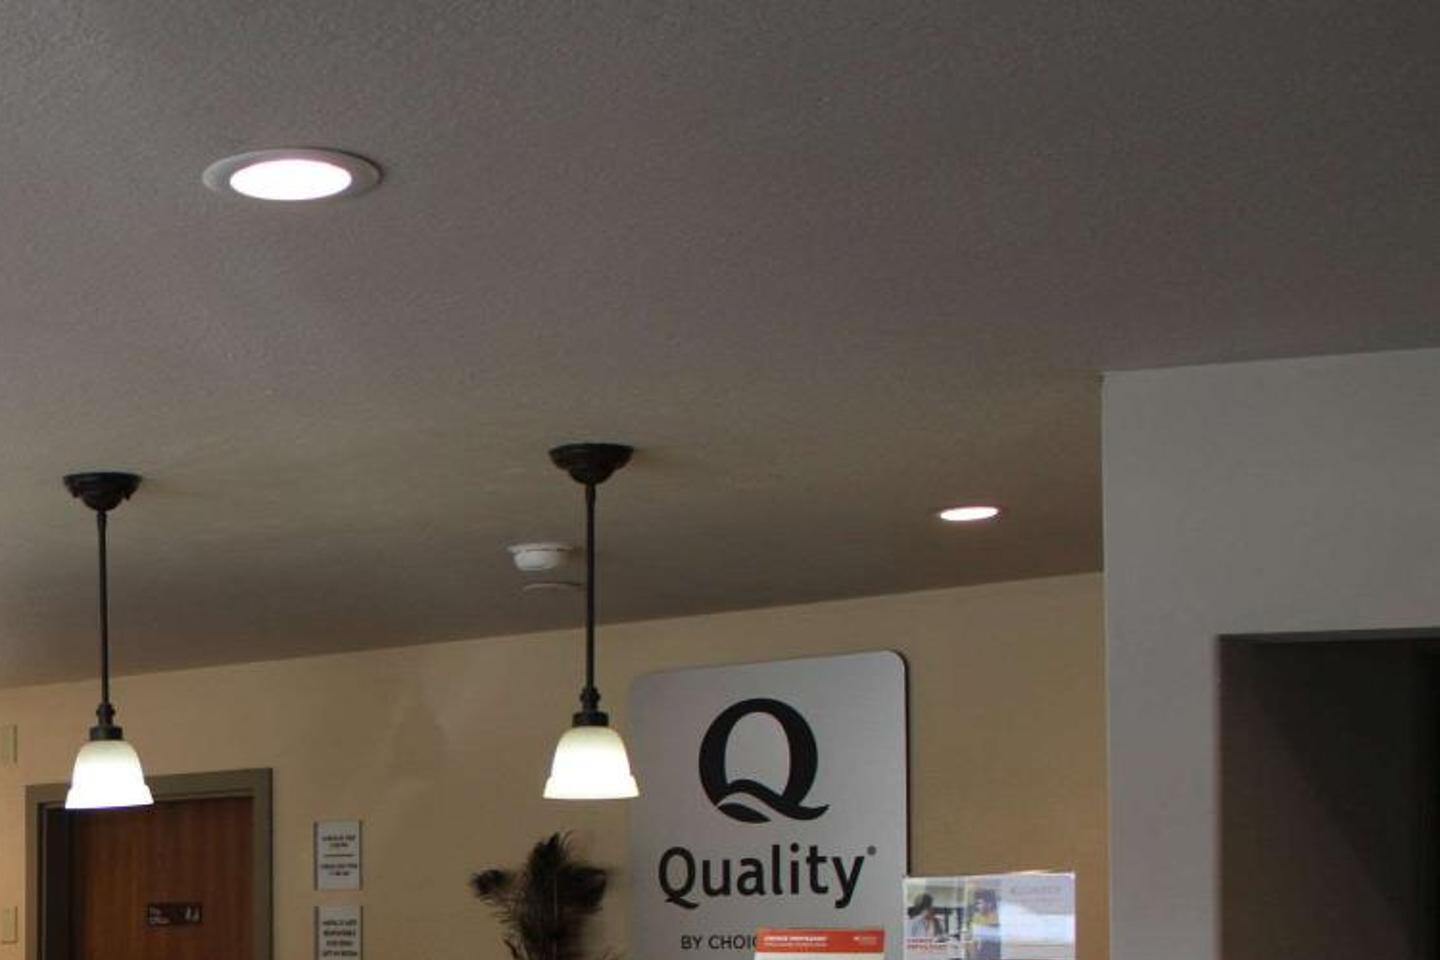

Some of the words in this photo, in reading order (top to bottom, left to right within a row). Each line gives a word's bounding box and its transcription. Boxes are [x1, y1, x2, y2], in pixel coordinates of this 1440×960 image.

[698, 698, 830, 824] Q
[658, 842, 865, 909] Quality
[680, 934, 702, 950] BY
